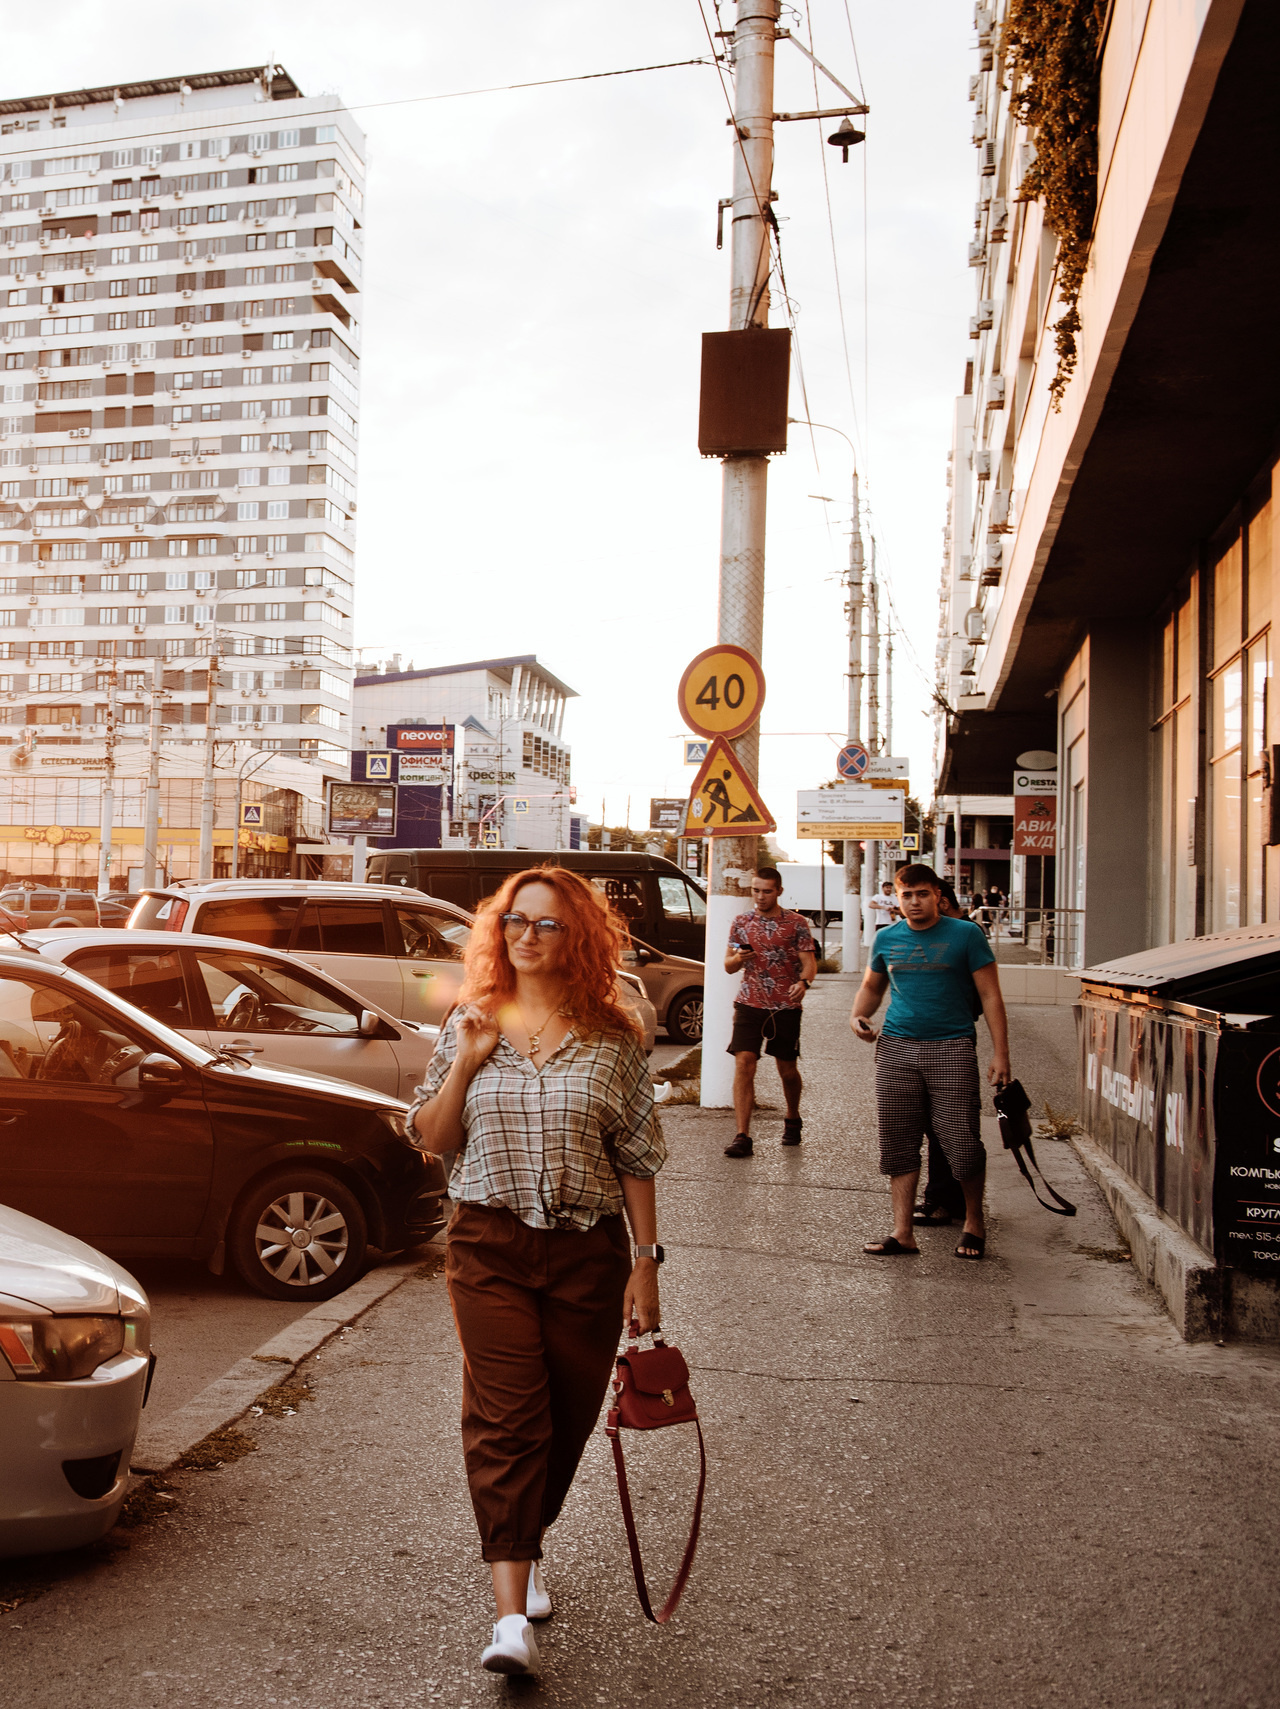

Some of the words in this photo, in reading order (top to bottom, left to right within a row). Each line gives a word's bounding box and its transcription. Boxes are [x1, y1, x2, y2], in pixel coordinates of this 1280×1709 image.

[695, 673, 745, 711] 40
[400, 756, 451, 765] ОФИСМА
[1016, 820, 1057, 832] АВИА
[1021, 836, 1054, 848] Ж/Д
[889, 943, 950, 963] EA7
